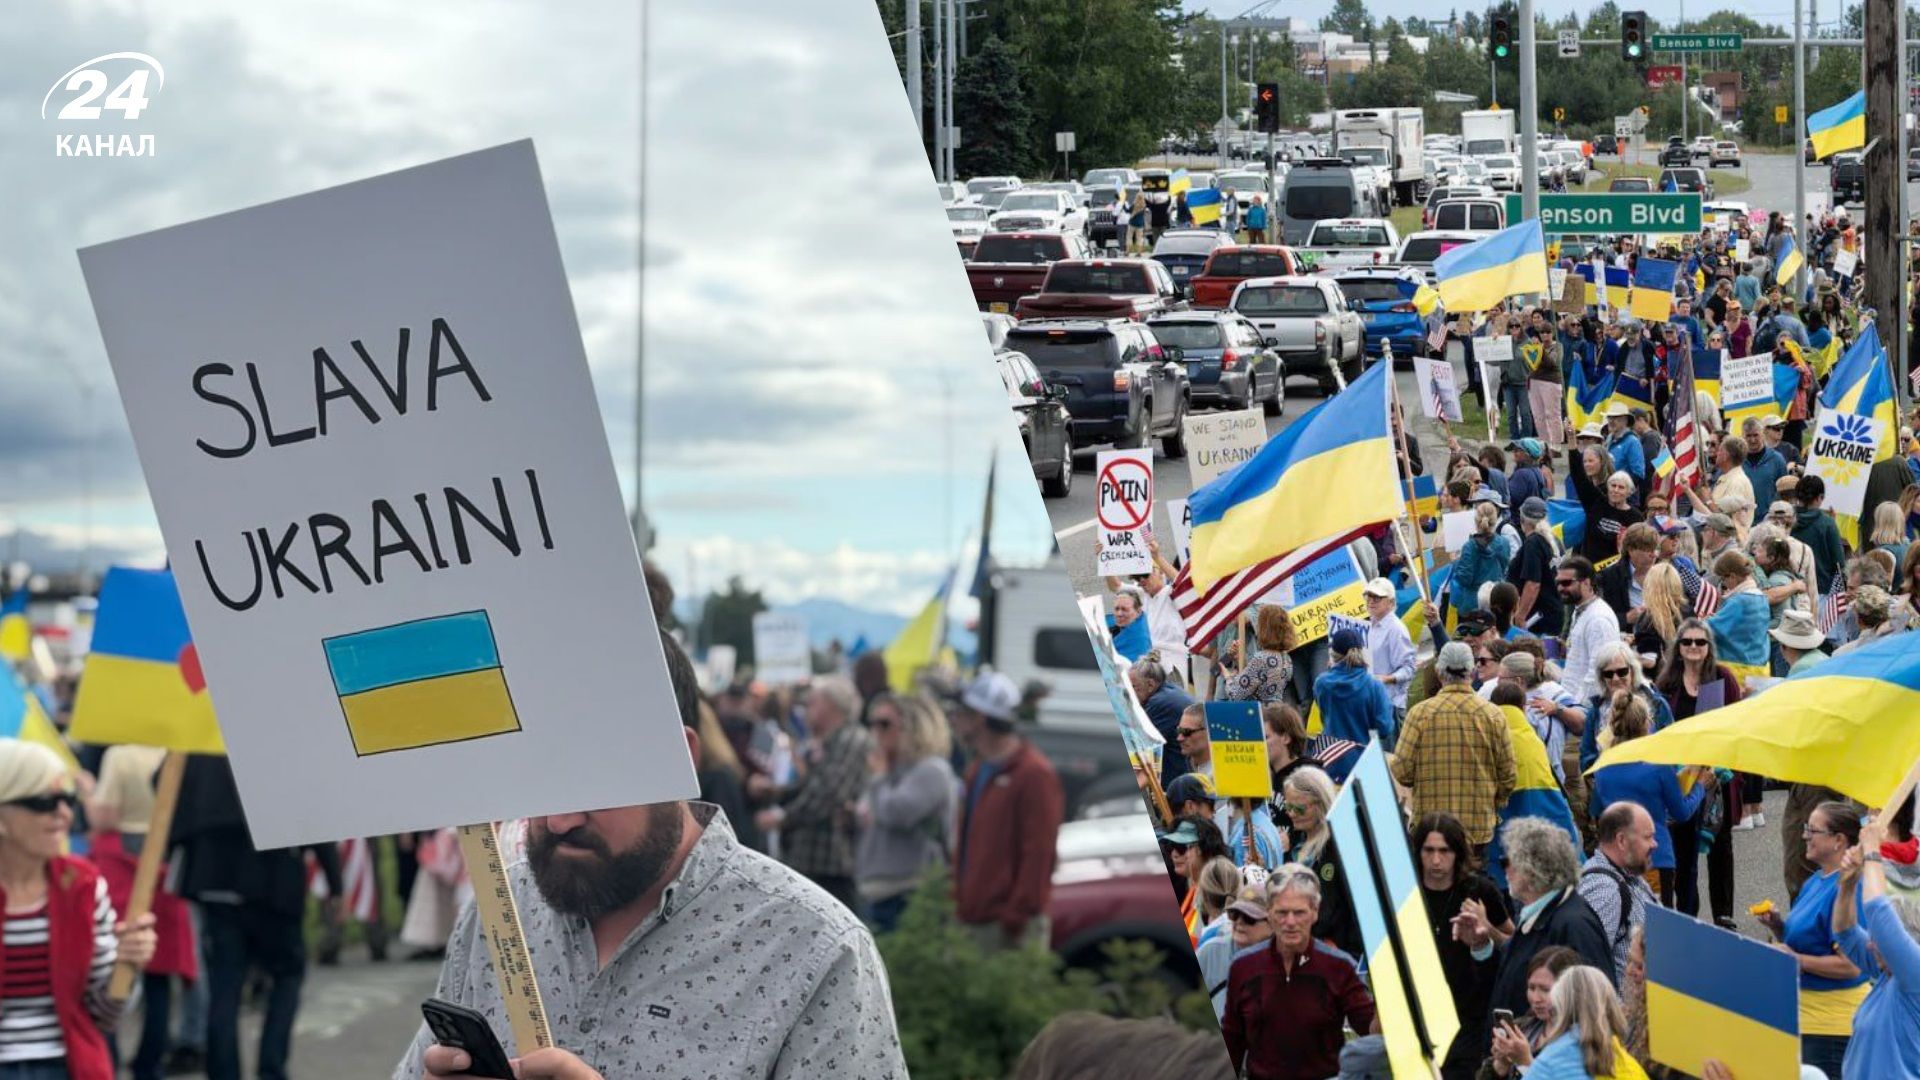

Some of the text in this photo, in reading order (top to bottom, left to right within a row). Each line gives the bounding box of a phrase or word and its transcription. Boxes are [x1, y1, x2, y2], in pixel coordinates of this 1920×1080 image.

[1659, 37, 1735, 47] Benson Blvd
[1541, 203, 1685, 224] enson Blvd
[192, 317, 492, 459] SLAVA
[1192, 418, 1256, 434] WE STAND
[1814, 438, 1875, 464] UKRAINE
[1101, 478, 1148, 507] PUTIN
[195, 469, 554, 612] UKRAINI
[1107, 531, 1135, 546] WAR
[1100, 549, 1145, 562] CRIMINAL
[1291, 596, 1346, 626] UKRAINE
[1296, 604, 1366, 641] OT FO ALE
